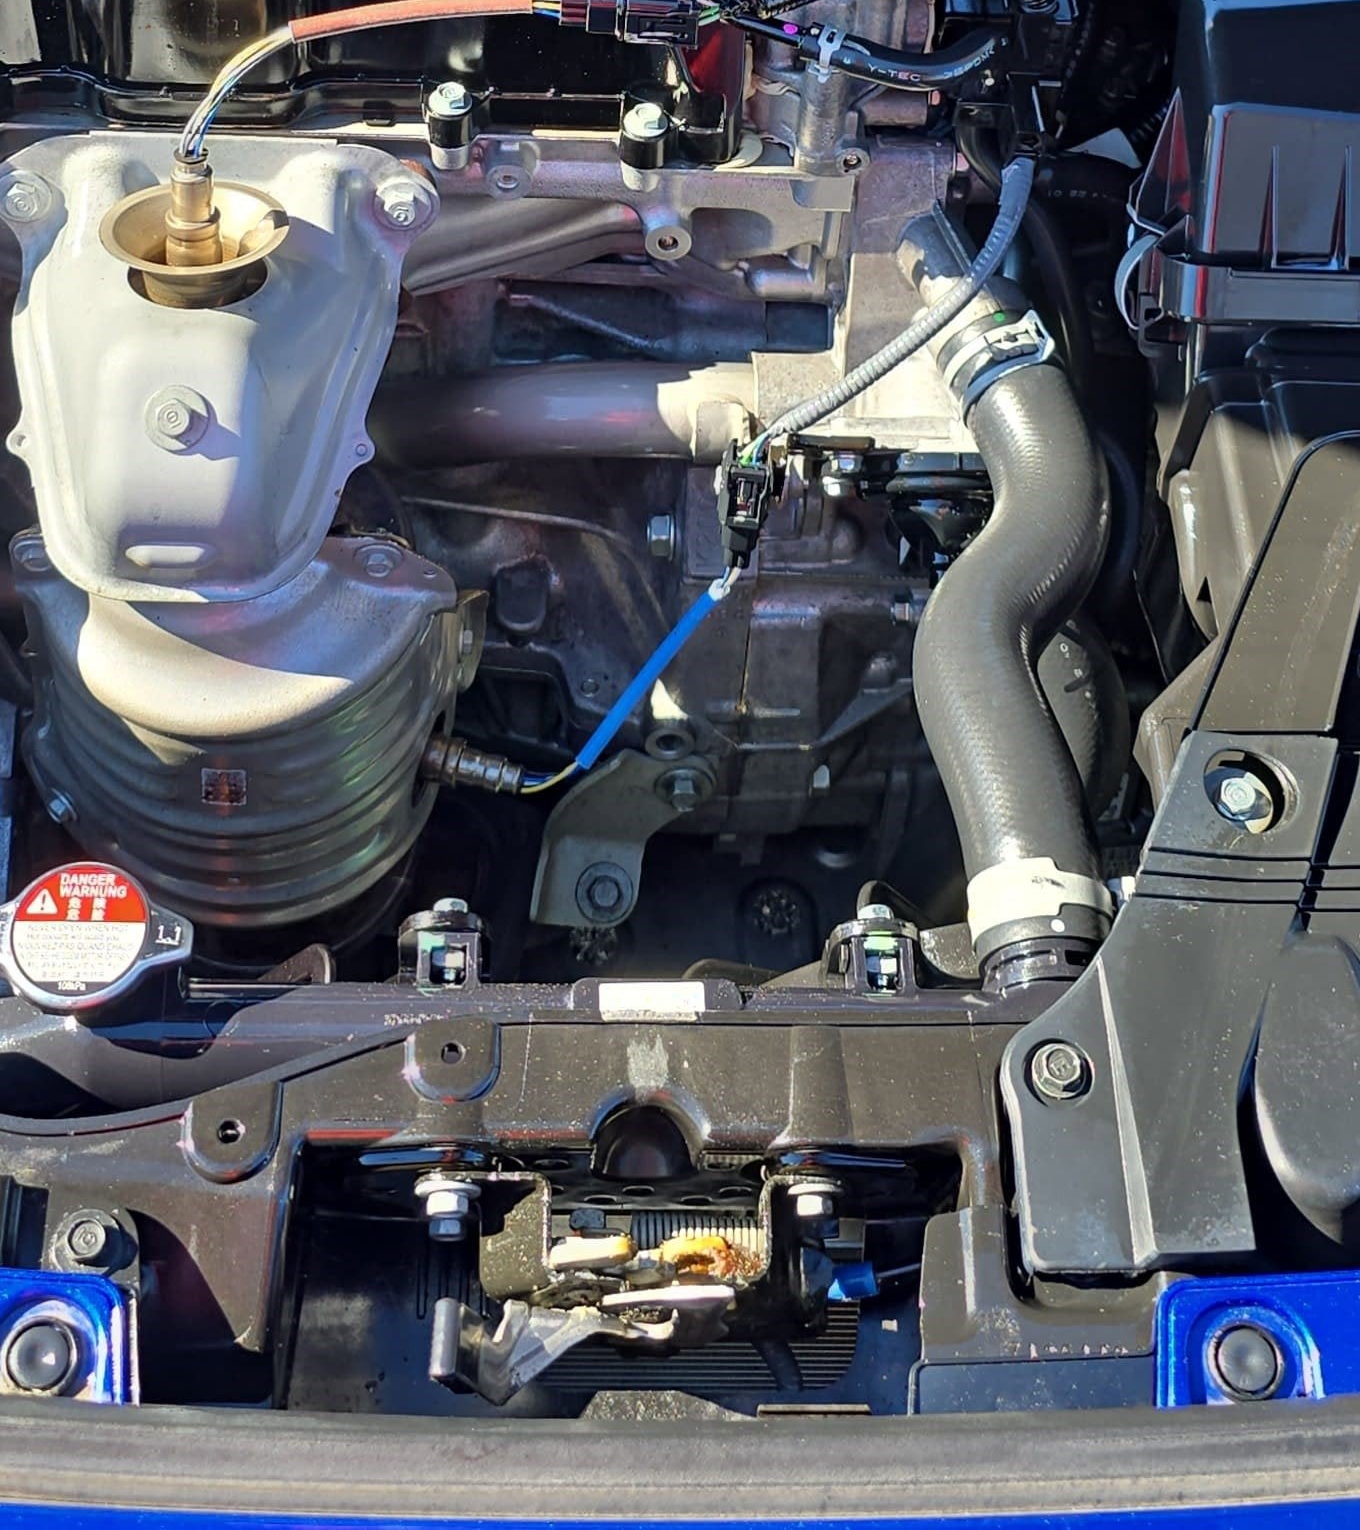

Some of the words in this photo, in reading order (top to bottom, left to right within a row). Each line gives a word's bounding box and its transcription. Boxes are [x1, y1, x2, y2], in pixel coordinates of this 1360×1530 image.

[868, 62, 921, 82] Y-TEC
[60, 873, 116, 885] DANGER
[59, 885, 127, 899] WARNUNG
